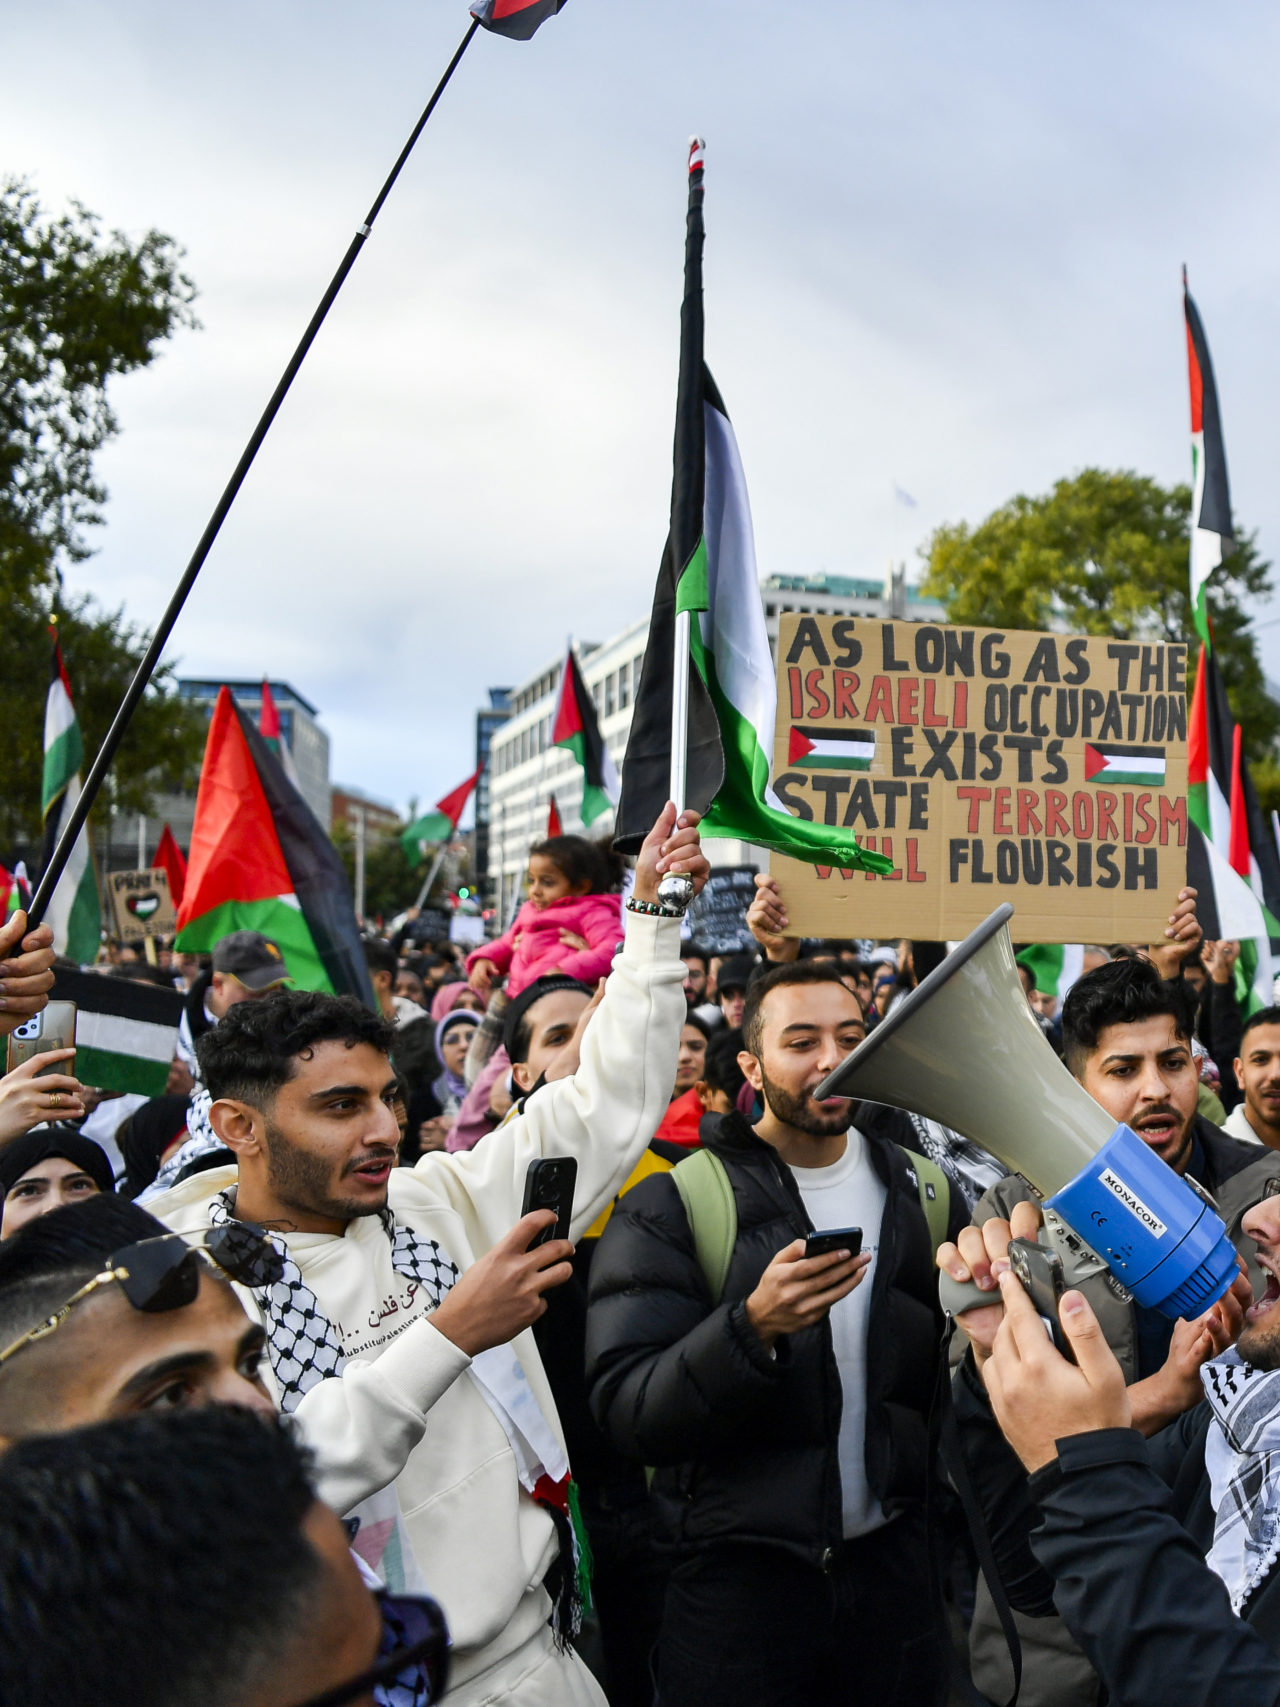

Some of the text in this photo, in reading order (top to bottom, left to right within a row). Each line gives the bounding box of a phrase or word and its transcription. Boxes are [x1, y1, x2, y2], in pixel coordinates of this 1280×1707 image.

[786, 617, 1187, 692] AS LONG AS THE
[788, 667, 1187, 742] ISRAELI OCCUPATION
[891, 726, 1069, 784] EXISTS
[772, 773, 1188, 846] STATE TERRORISM
[950, 839, 1158, 890] FLOURISH
